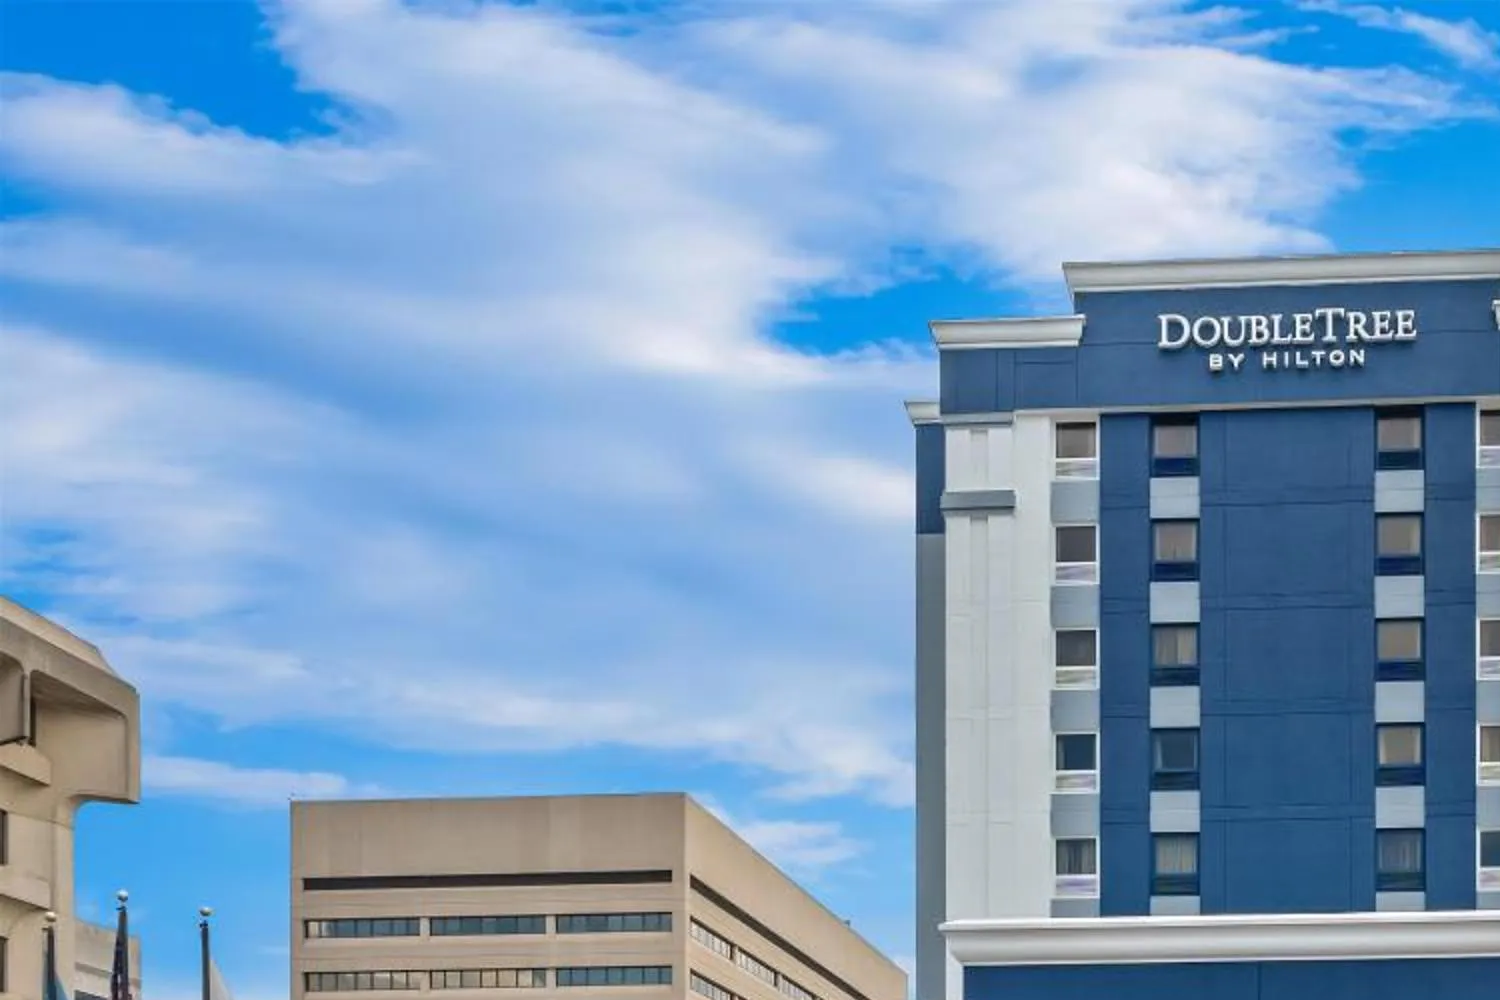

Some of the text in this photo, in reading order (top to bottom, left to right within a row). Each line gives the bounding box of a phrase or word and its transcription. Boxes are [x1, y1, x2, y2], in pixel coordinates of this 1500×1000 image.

[1158, 308, 1417, 348] DOUBLETREE
[1209, 349, 1366, 372] BY HILTON
